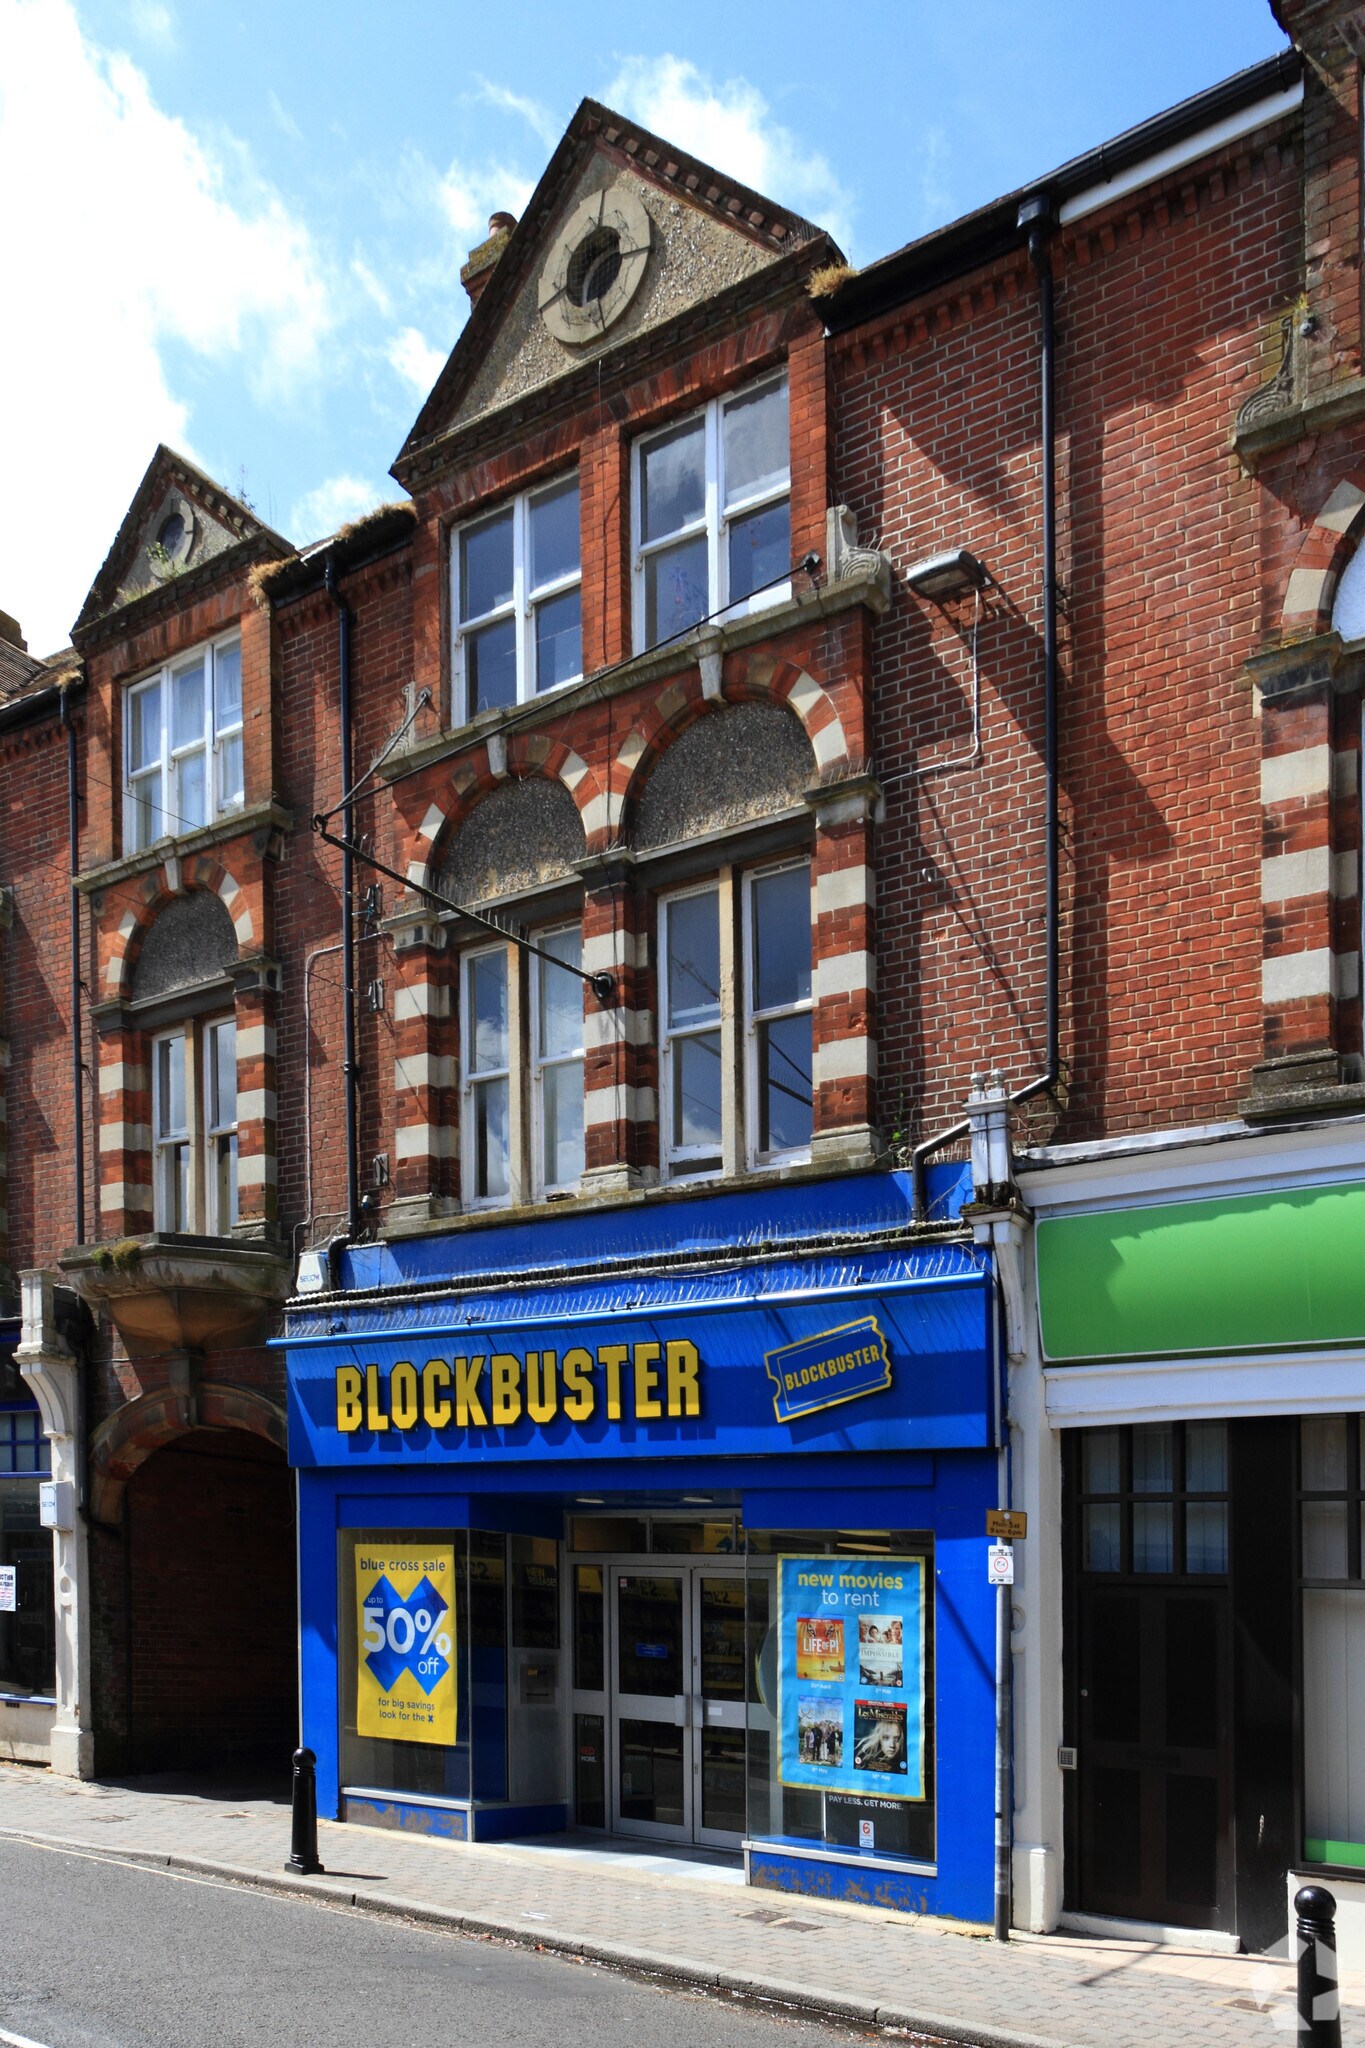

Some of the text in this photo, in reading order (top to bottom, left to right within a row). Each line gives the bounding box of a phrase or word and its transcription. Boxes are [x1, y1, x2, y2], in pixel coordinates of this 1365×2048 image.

[784, 1344, 880, 1391] BLOCKBUSTER
[335, 1339, 700, 1432] BLOCKBUSTER
[360, 1558, 445, 1572] blue cross sale
[798, 1571, 904, 1590] new movies
[367, 1596, 384, 1605] up to
[821, 1589, 880, 1607] to rent
[363, 1607, 452, 1657] 50%
[803, 1638, 823, 1653] LIFE
[829, 1639, 839, 1653] PI
[418, 1657, 439, 1675] off
[378, 1697, 435, 1712] for big savings
[379, 1710, 397, 1720] look
[398, 1710, 410, 1721] for
[412, 1711, 426, 1722] the
[828, 1795, 843, 1804] PAY
[843, 1796, 863, 1806] LESS.
[863, 1799, 879, 1808] GET
